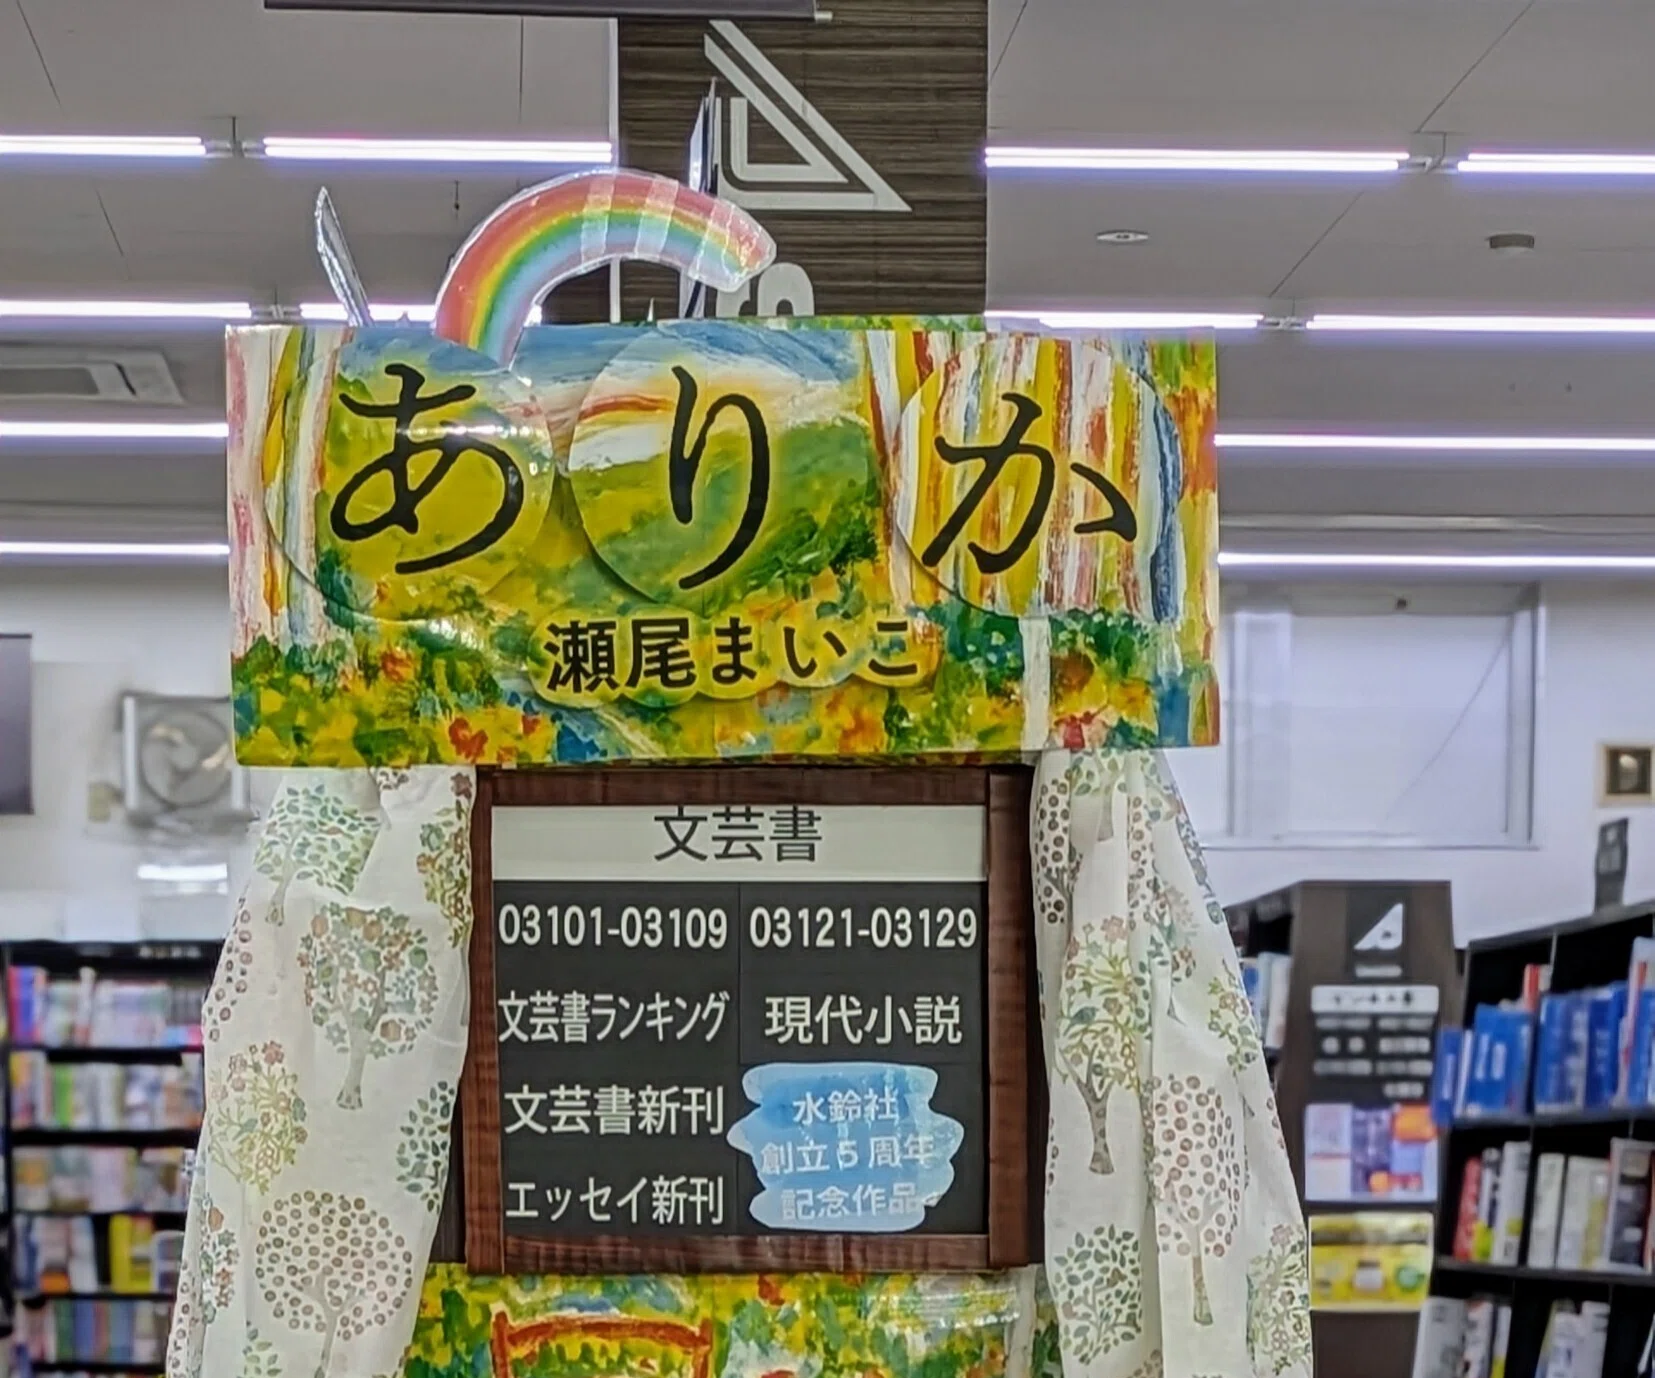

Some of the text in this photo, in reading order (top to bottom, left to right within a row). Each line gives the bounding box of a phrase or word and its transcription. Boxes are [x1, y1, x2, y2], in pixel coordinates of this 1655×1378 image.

[330, 364, 1138, 590] ありか
[544, 618, 922, 691] 瀬尾まいこ
[653, 805, 822, 862] 文芸書
[498, 903, 728, 949] 03101-03109
[750, 906, 978, 948] 03121-03129
[498, 989, 731, 1043] 文芸書ランキング
[764, 994, 963, 1045] 現代小説
[504, 1083, 724, 1135] 文芸書新刊
[792, 1086, 900, 1125] 水鈴社
[505, 1174, 723, 1225] エッセイ新刊
[780, 1181, 918, 1221] 記念作品
